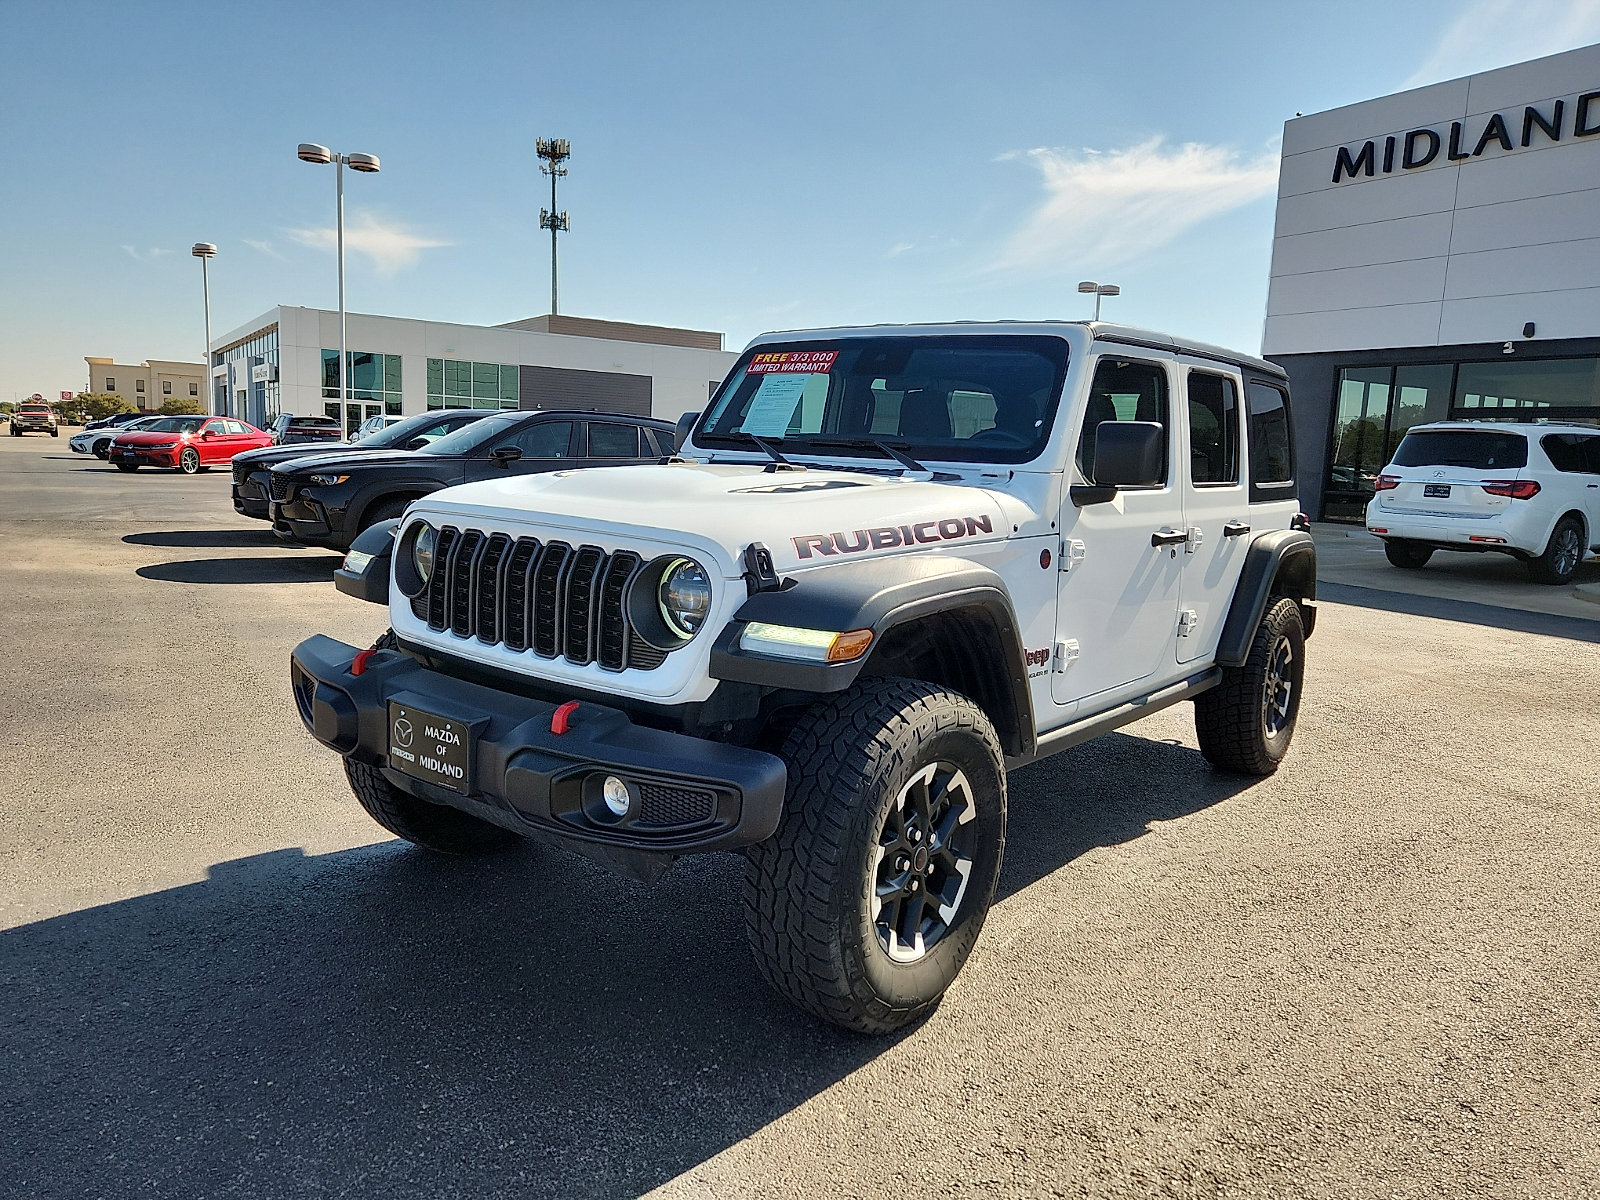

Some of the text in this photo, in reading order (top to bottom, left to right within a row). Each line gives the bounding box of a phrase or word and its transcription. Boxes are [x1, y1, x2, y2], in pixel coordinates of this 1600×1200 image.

[1331, 91, 1600, 184] MIDLAND
[747, 362, 831, 372] LIMITED WARRANTY
[754, 352, 834, 363] FREE 3/3,000
[790, 514, 993, 560] RUBICON
[424, 725, 461, 746] MAZDA
[391, 746, 415, 763] mazda
[435, 744, 447, 756] OF
[419, 755, 464, 779] MIDLAND
